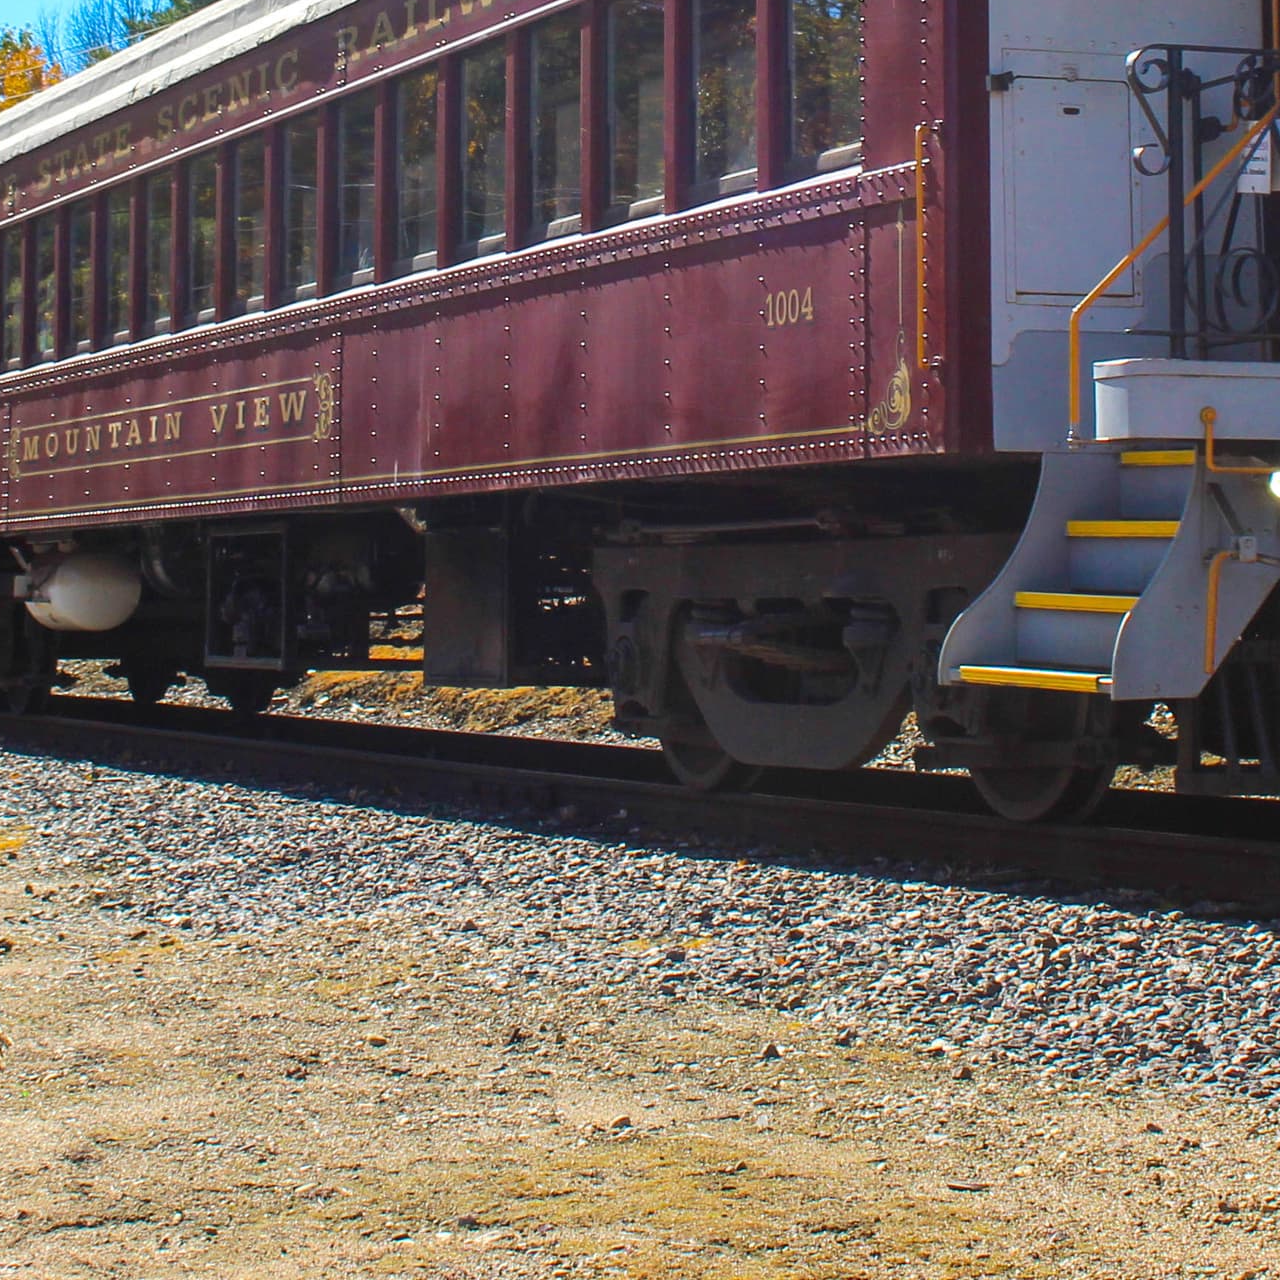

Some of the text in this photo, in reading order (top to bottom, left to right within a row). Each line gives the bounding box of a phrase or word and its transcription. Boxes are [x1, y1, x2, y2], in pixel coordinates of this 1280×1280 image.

[38, 122, 132, 192] STATE
[157, 48, 299, 141] SCENIC
[765, 286, 814, 327] 1004
[23, 389, 308, 462] MOUNTAIN VIEW
